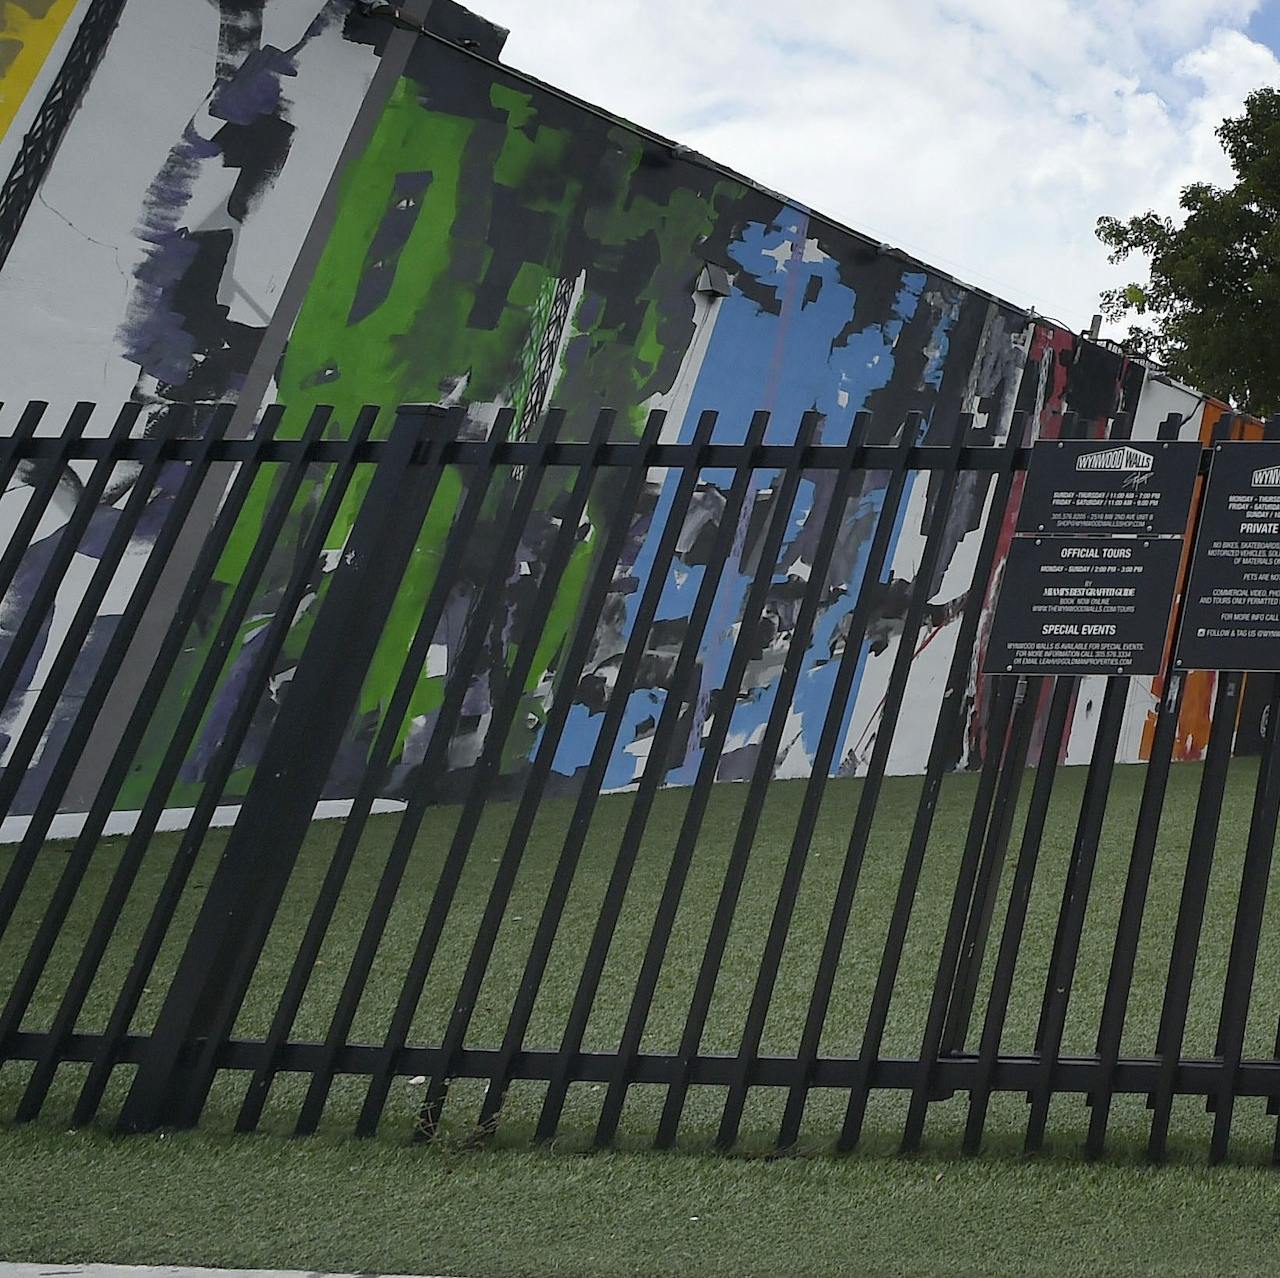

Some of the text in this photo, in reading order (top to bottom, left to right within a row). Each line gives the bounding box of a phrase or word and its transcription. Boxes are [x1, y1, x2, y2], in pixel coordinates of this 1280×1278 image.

[1079, 449, 1152, 468] WYNWOOD WALLS
[1240, 523, 1280, 534] PRIVATE
[1061, 548, 1132, 558] OFFICIAL TOURS
[1070, 588, 1085, 596] BEST
[1086, 588, 1115, 596] GRAFFITI
[1115, 588, 1136, 596] GUIDE
[1221, 613, 1234, 621] FOR
[1042, 625, 1117, 635] SPECIAL EVENTS
[1207, 629, 1230, 637] FOLLOW
